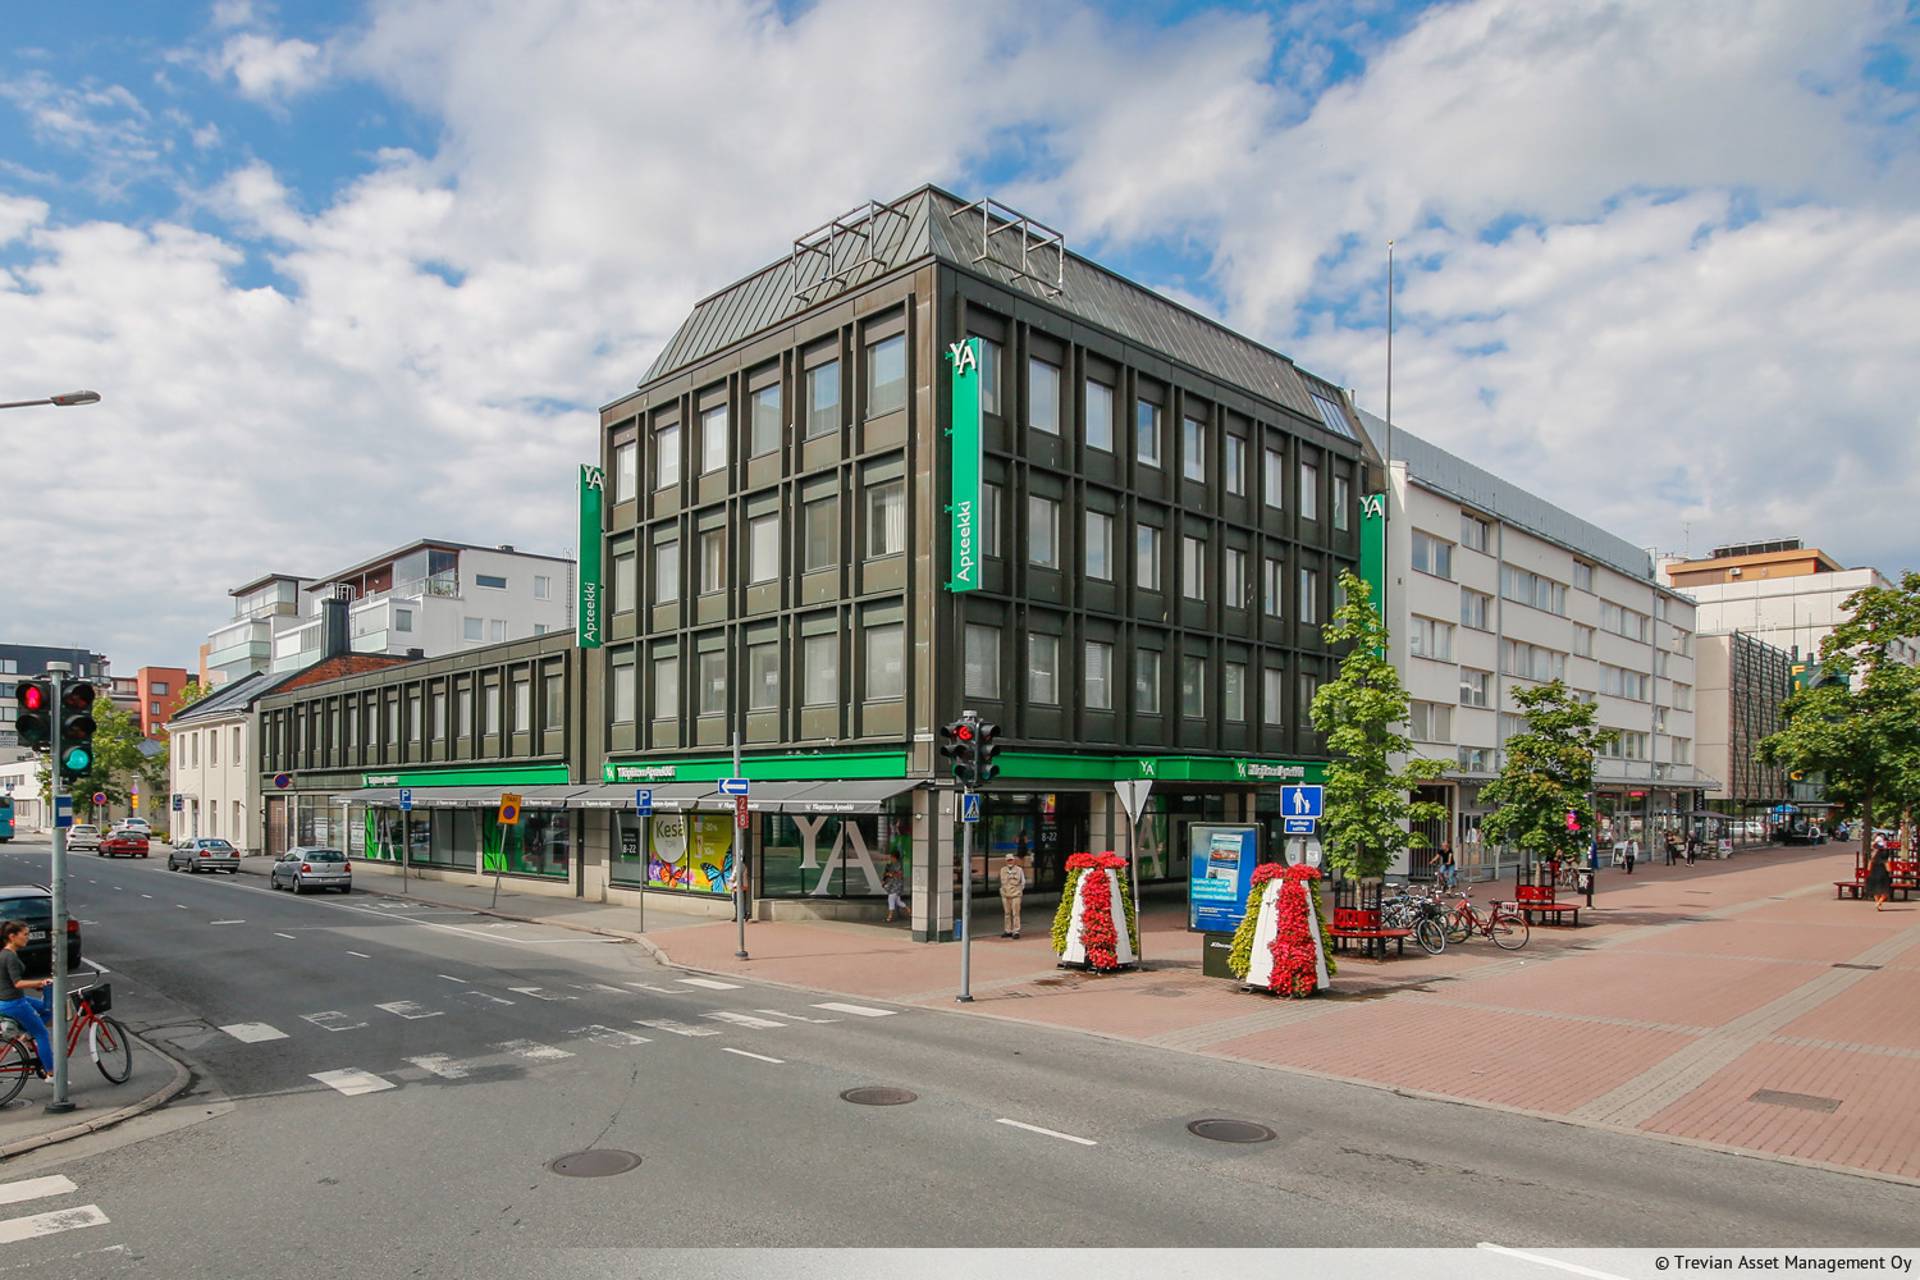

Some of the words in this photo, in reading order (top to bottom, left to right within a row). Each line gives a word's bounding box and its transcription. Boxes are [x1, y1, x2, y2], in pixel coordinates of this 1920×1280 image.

[949, 338, 976, 374] YA
[582, 463, 604, 490] YA
[1360, 495, 1382, 518] YA
[957, 501, 974, 582] Apteekki
[583, 581, 598, 642] Apteekki
[1139, 760, 1154, 776] YA
[401, 790, 409, 801] P
[640, 790, 650, 806] P
[791, 815, 889, 896] YA
